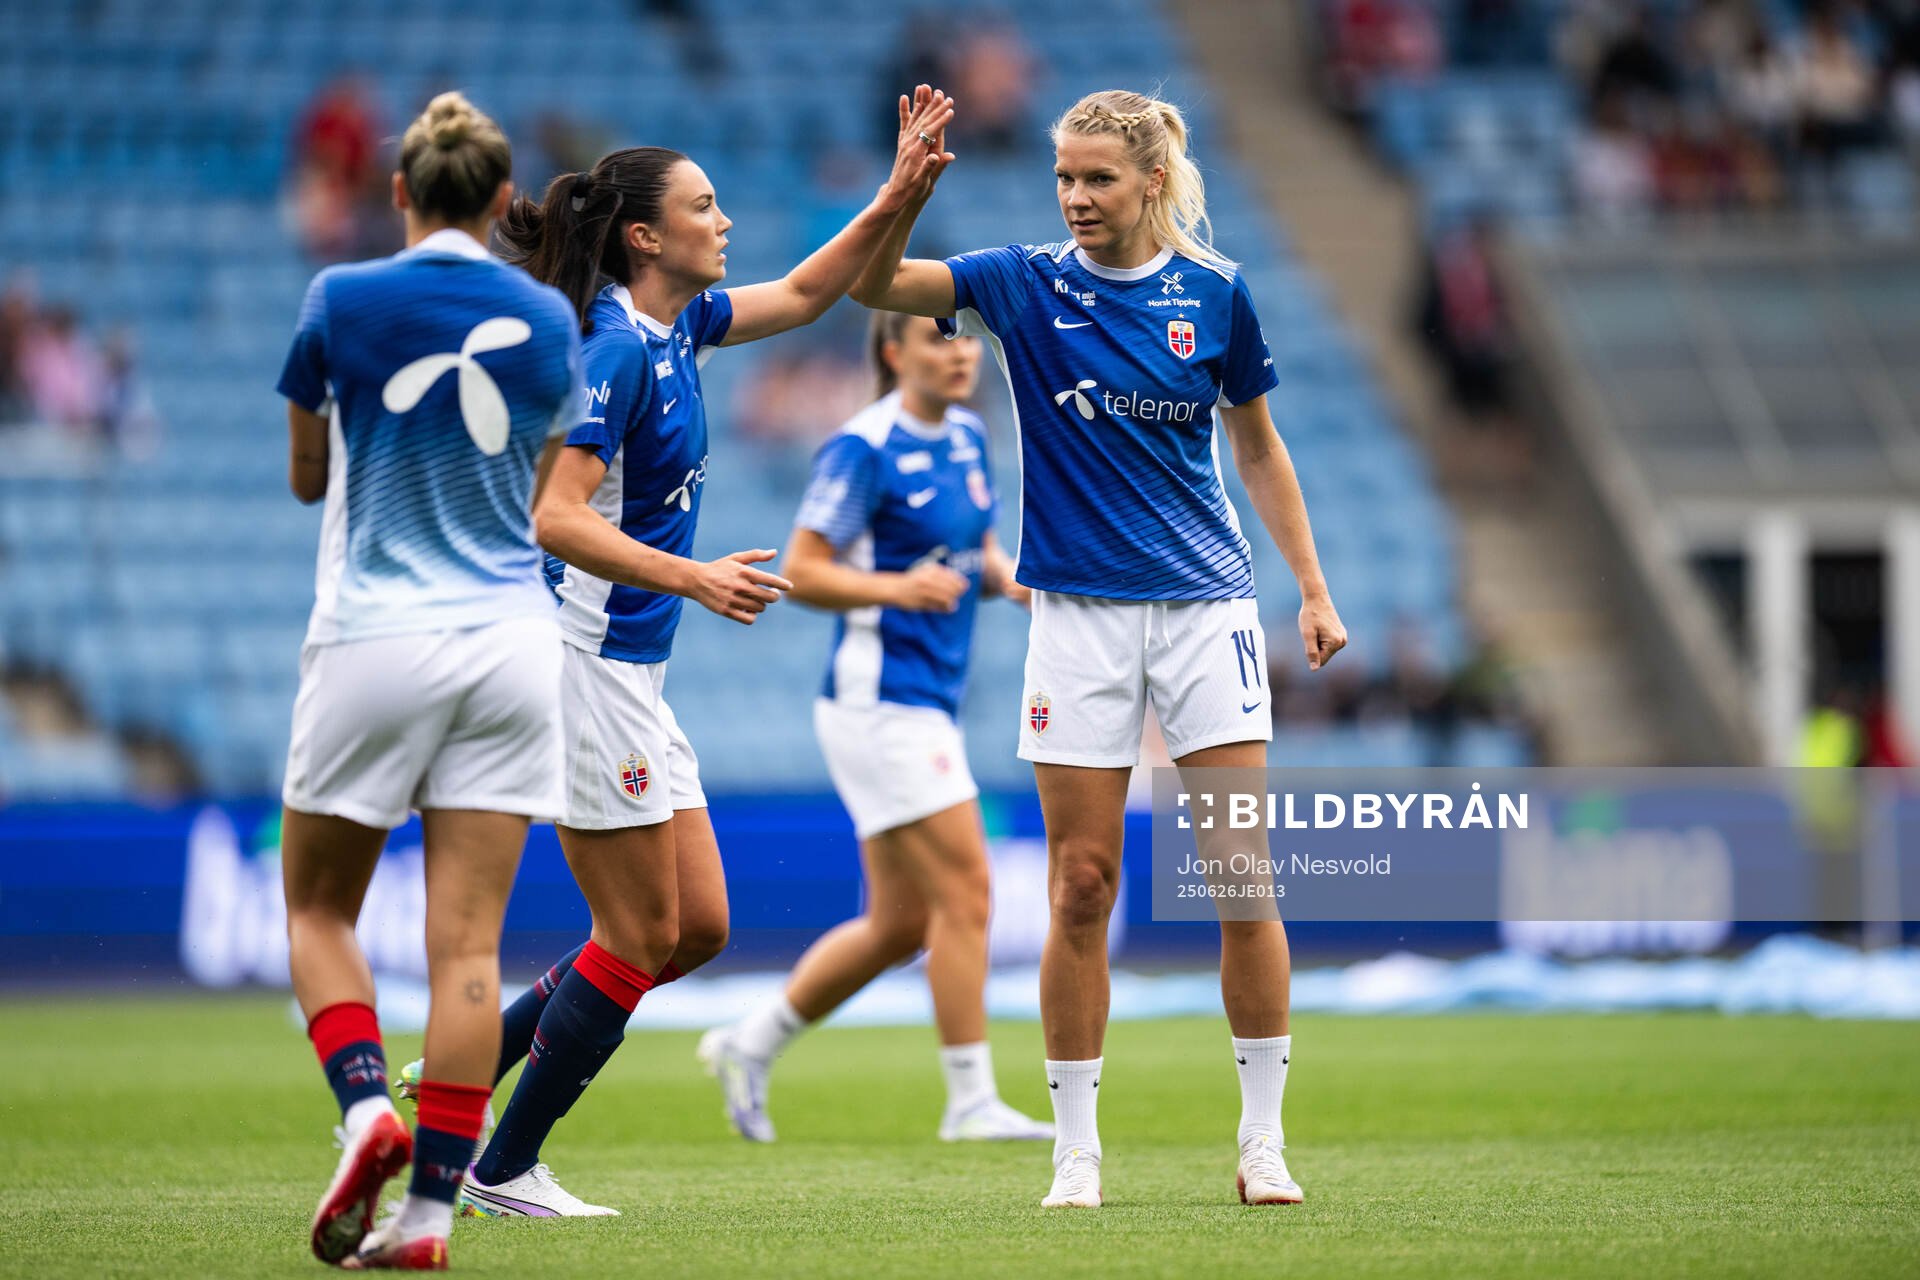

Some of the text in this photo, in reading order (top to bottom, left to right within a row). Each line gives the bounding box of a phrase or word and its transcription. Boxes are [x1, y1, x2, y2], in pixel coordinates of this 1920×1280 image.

[1147, 298, 1201, 308] Norsk Tipping
[1103, 390, 1199, 421] telenor
[1230, 629, 1261, 690] 14
